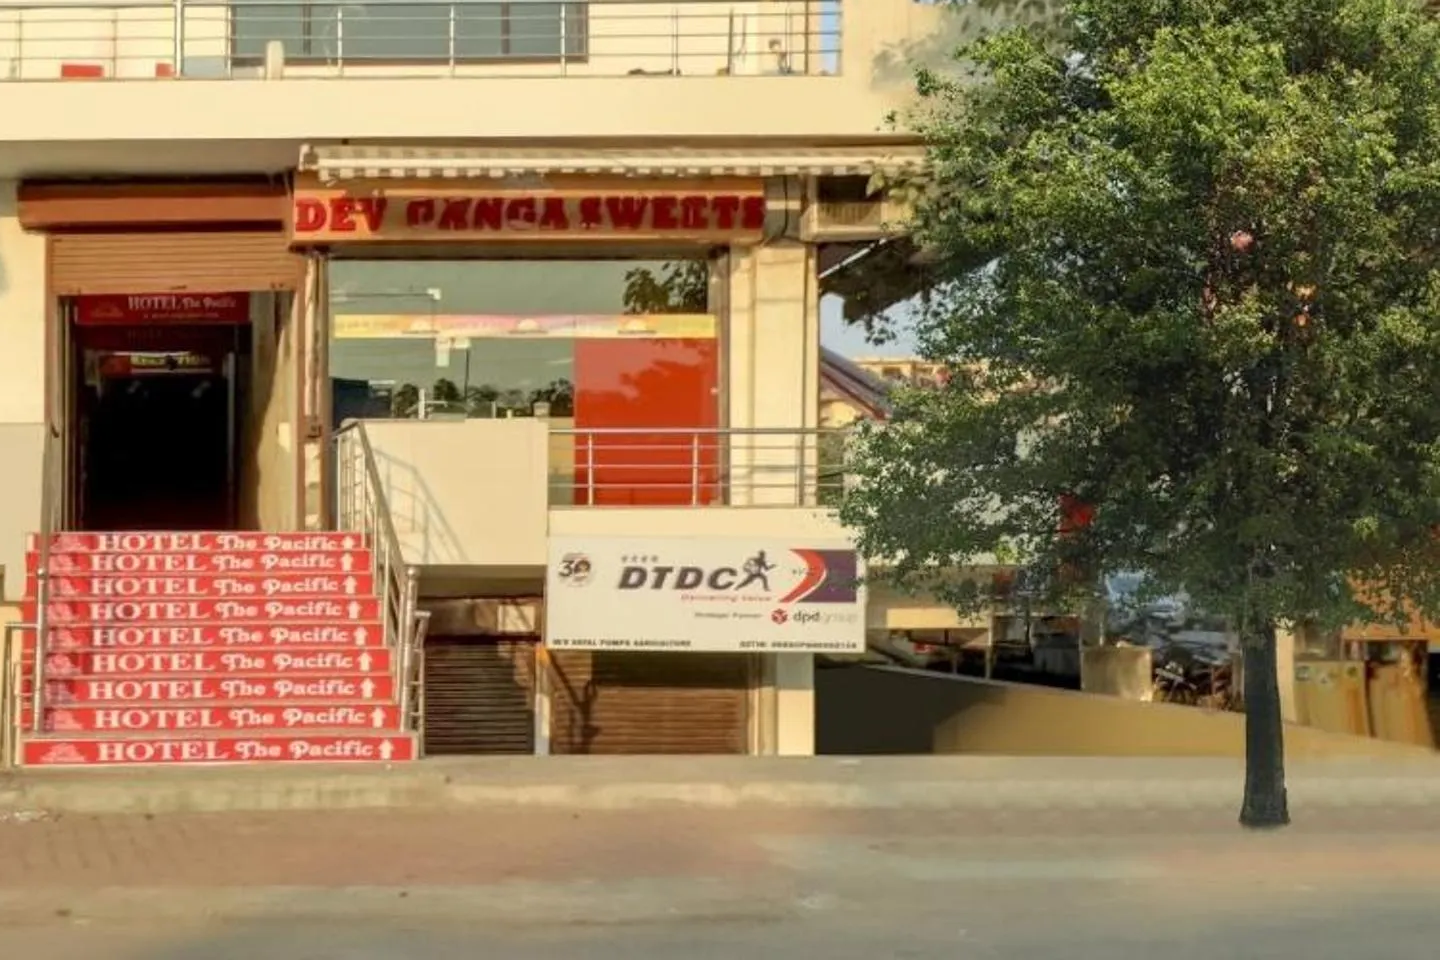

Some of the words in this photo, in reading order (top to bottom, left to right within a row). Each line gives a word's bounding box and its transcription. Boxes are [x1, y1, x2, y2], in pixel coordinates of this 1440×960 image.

[294, 197, 387, 232] DEV
[128, 296, 176, 310] HOTEL
[97, 533, 211, 551] HOTEL
[215, 534, 257, 551] The
[263, 536, 338, 551] Pacific
[91, 554, 206, 571] HOTEL
[212, 555, 253, 570] The
[260, 554, 336, 570] Pacific
[90, 577, 208, 594] HOTEL
[213, 578, 255, 594] The
[262, 576, 338, 595] Pacific
[617, 566, 738, 591] DTDC
[90, 602, 210, 620] HOTEL
[215, 602, 258, 619] The
[264, 600, 342, 619] Pacific
[793, 609, 821, 624] dpd
[92, 627, 212, 646] HOTEL
[219, 627, 262, 645] The
[270, 626, 348, 645] Pacific
[92, 652, 215, 672] HOTEL
[220, 653, 265, 671] The
[272, 652, 353, 671] Pacific
[89, 680, 215, 700] HOTEL
[220, 680, 266, 699] The
[273, 679, 355, 700] Pacific
[95, 709, 222, 729] HOTEL
[228, 709, 274, 728] The
[282, 707, 365, 728] Pacific
[98, 741, 228, 761] HOTEL
[234, 741, 281, 760] The
[289, 741, 373, 760] Pacific
